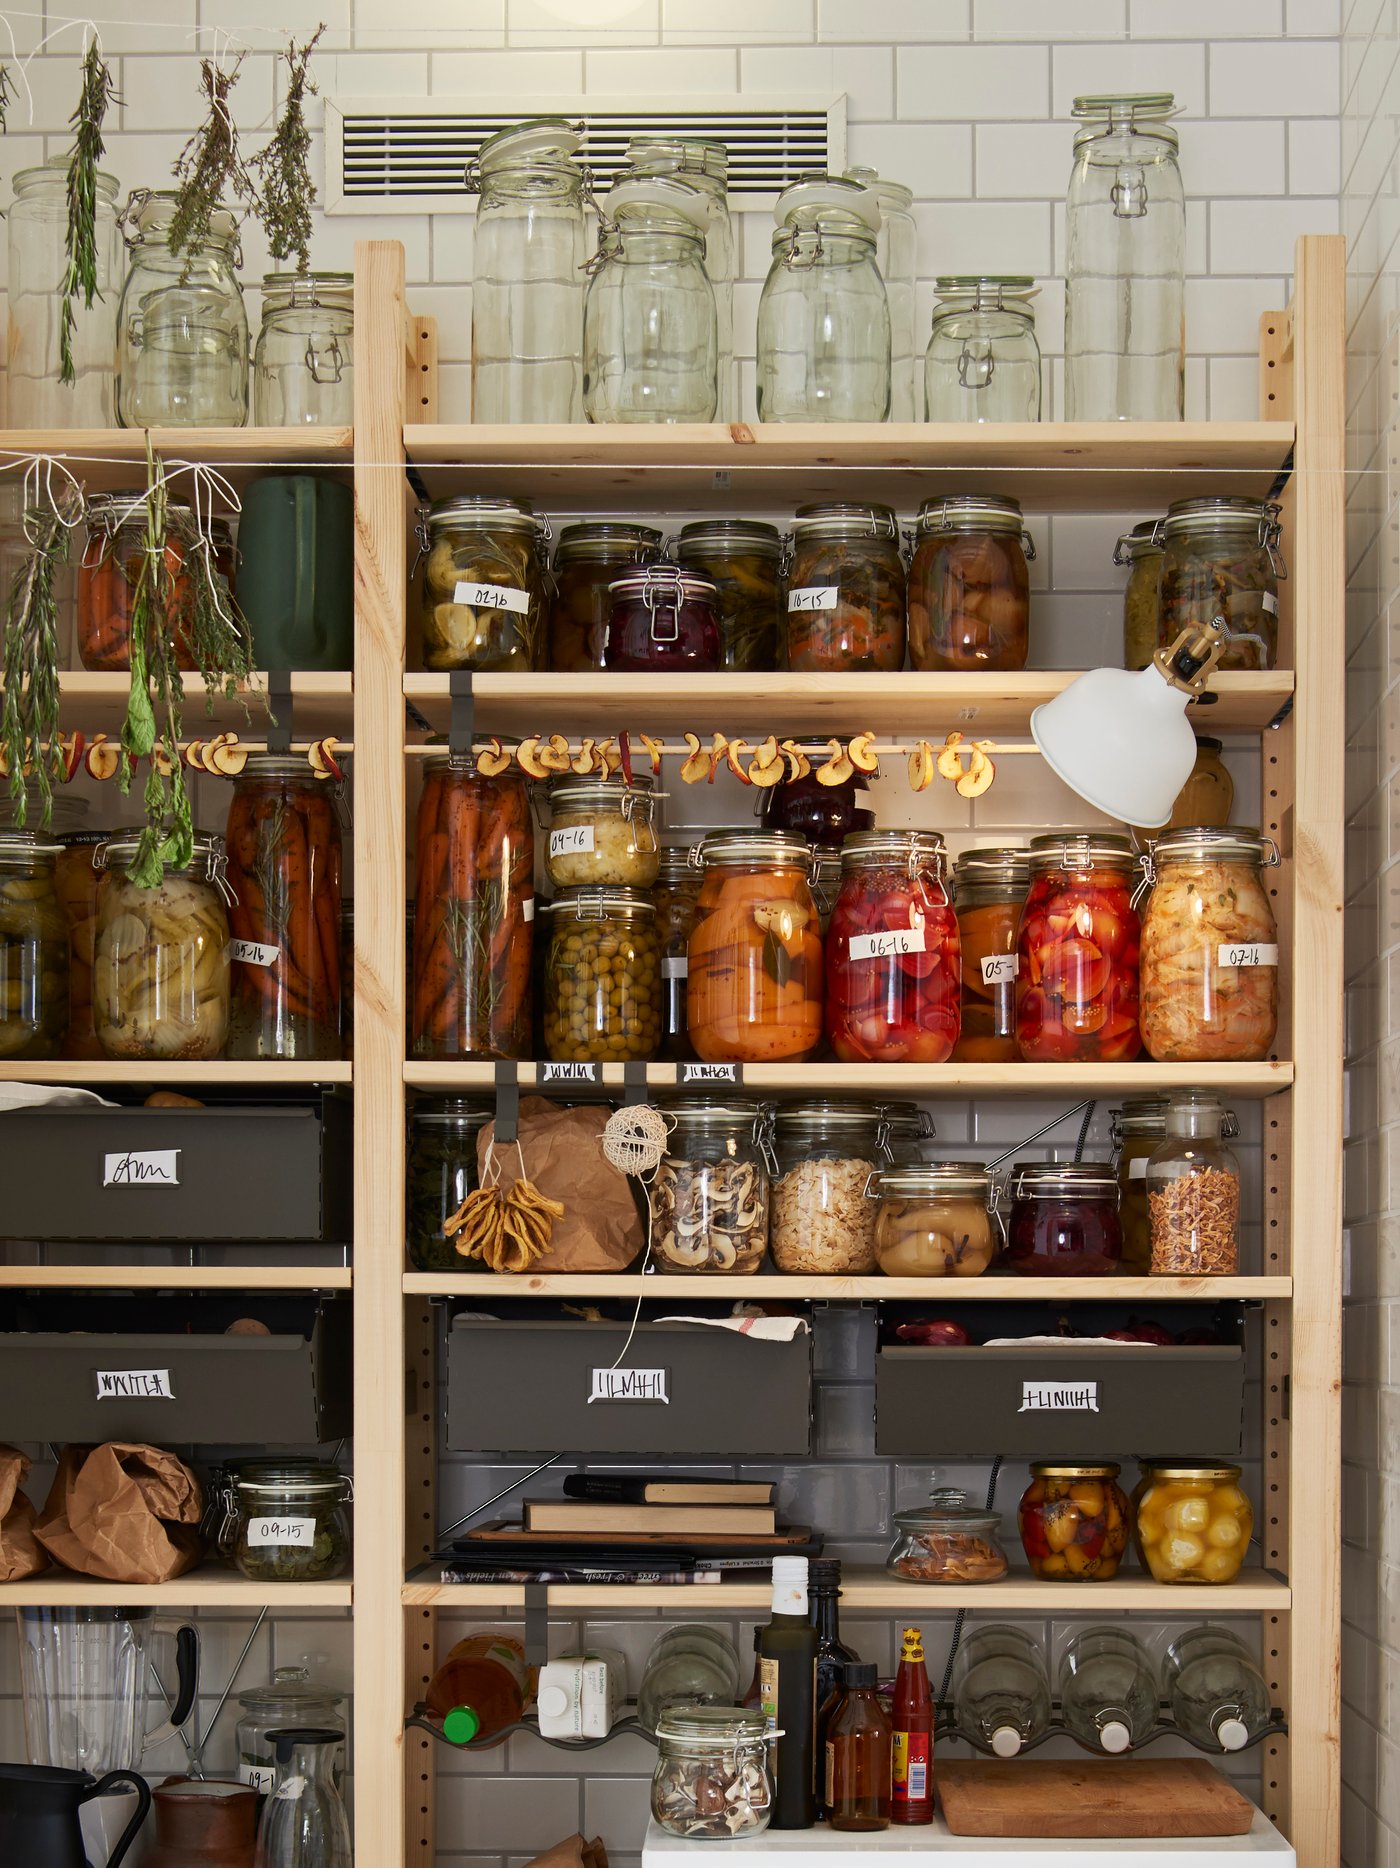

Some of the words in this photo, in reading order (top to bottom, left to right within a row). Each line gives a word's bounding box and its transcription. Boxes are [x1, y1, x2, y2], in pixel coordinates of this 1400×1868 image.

[475, 590, 508, 607] 02-16
[551, 832, 585, 850] 04-16
[870, 937, 909, 955] 06-16
[1230, 948, 1259, 965] 07-16
[261, 1522, 304, 1538] 09-15
[465, 1572, 496, 1582] Fields
[585, 1573, 612, 1582] Fresh
